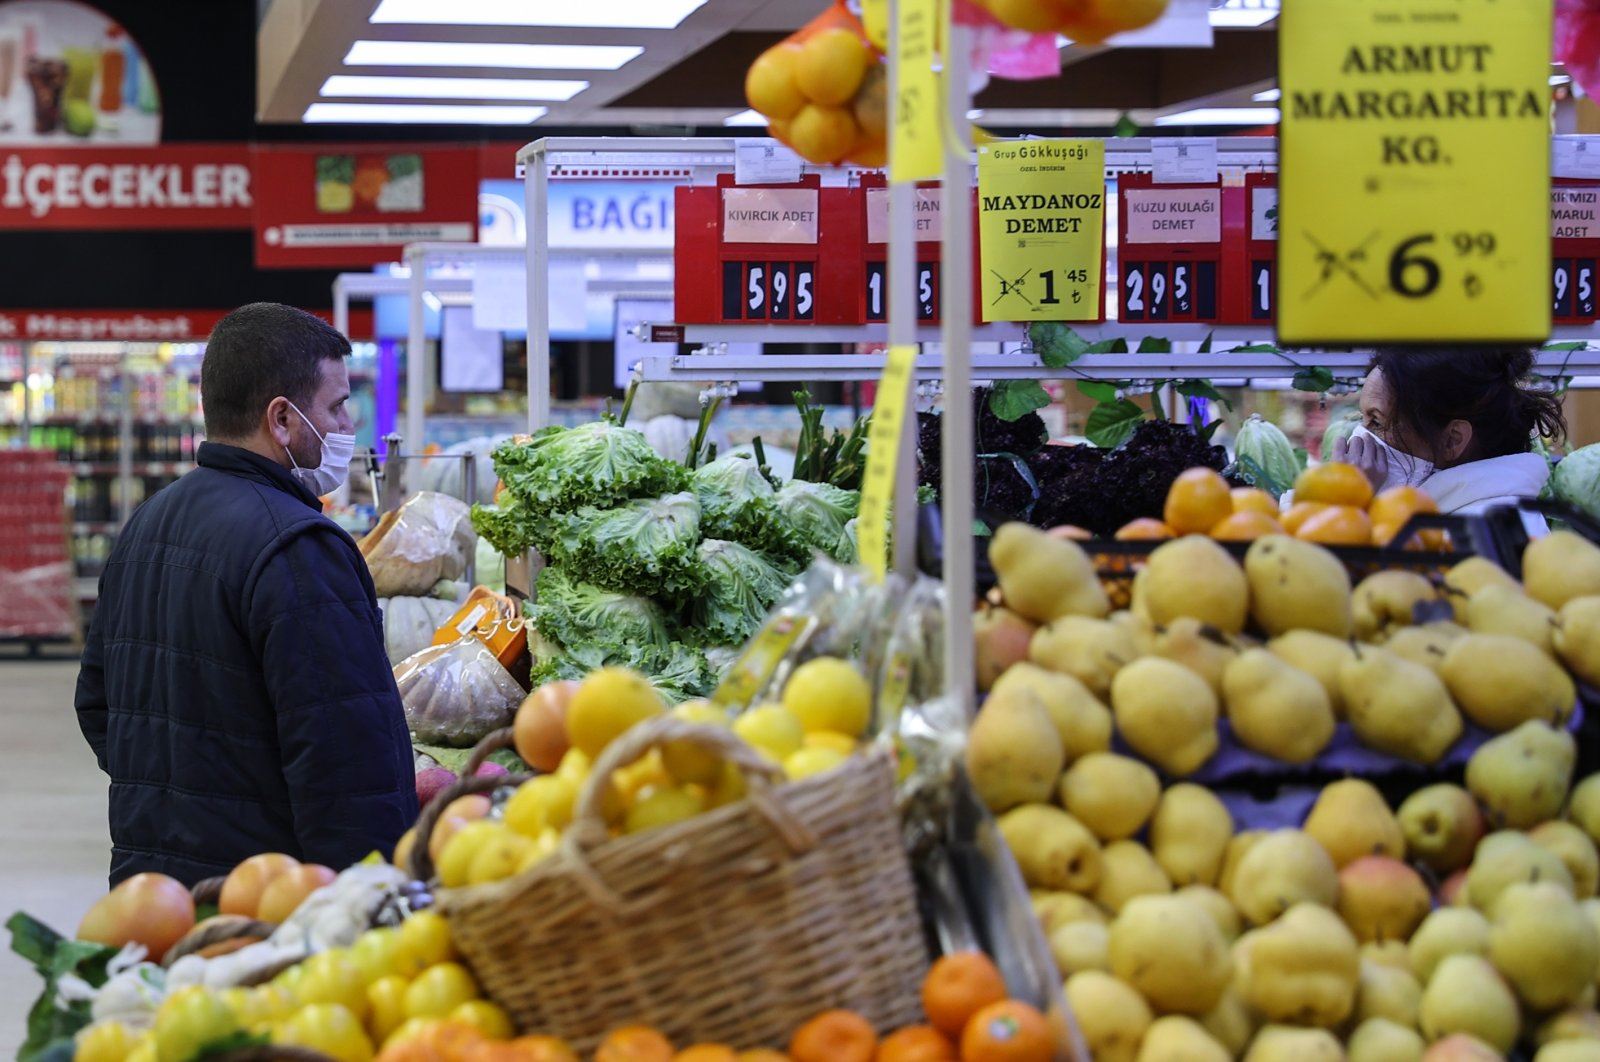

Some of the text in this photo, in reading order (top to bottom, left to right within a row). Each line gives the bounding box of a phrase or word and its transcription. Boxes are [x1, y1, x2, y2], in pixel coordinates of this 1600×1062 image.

[1342, 45, 1492, 73] ARMUT
[1293, 84, 1543, 119] MARGARİTA
[994, 145, 1088, 160] Grup Gökkuşağı
[1382, 136, 1453, 165] KG.
[4, 155, 251, 217] İÇECEKLER
[983, 194, 1101, 211] MAYDANOZ
[1133, 200, 1214, 213] KUZU KULAĞI
[728, 210, 815, 222] KIVIRCIK ADET
[1551, 210, 1595, 221] MARUL
[1006, 218, 1082, 234] DEMET
[1152, 220, 1195, 230] DEMET
[1556, 227, 1588, 237] ADET
[1388, 233, 1441, 300] 6
[1453, 233, 1497, 256] 99
[1039, 270, 1060, 304] 1
[1067, 270, 1087, 282] 45
